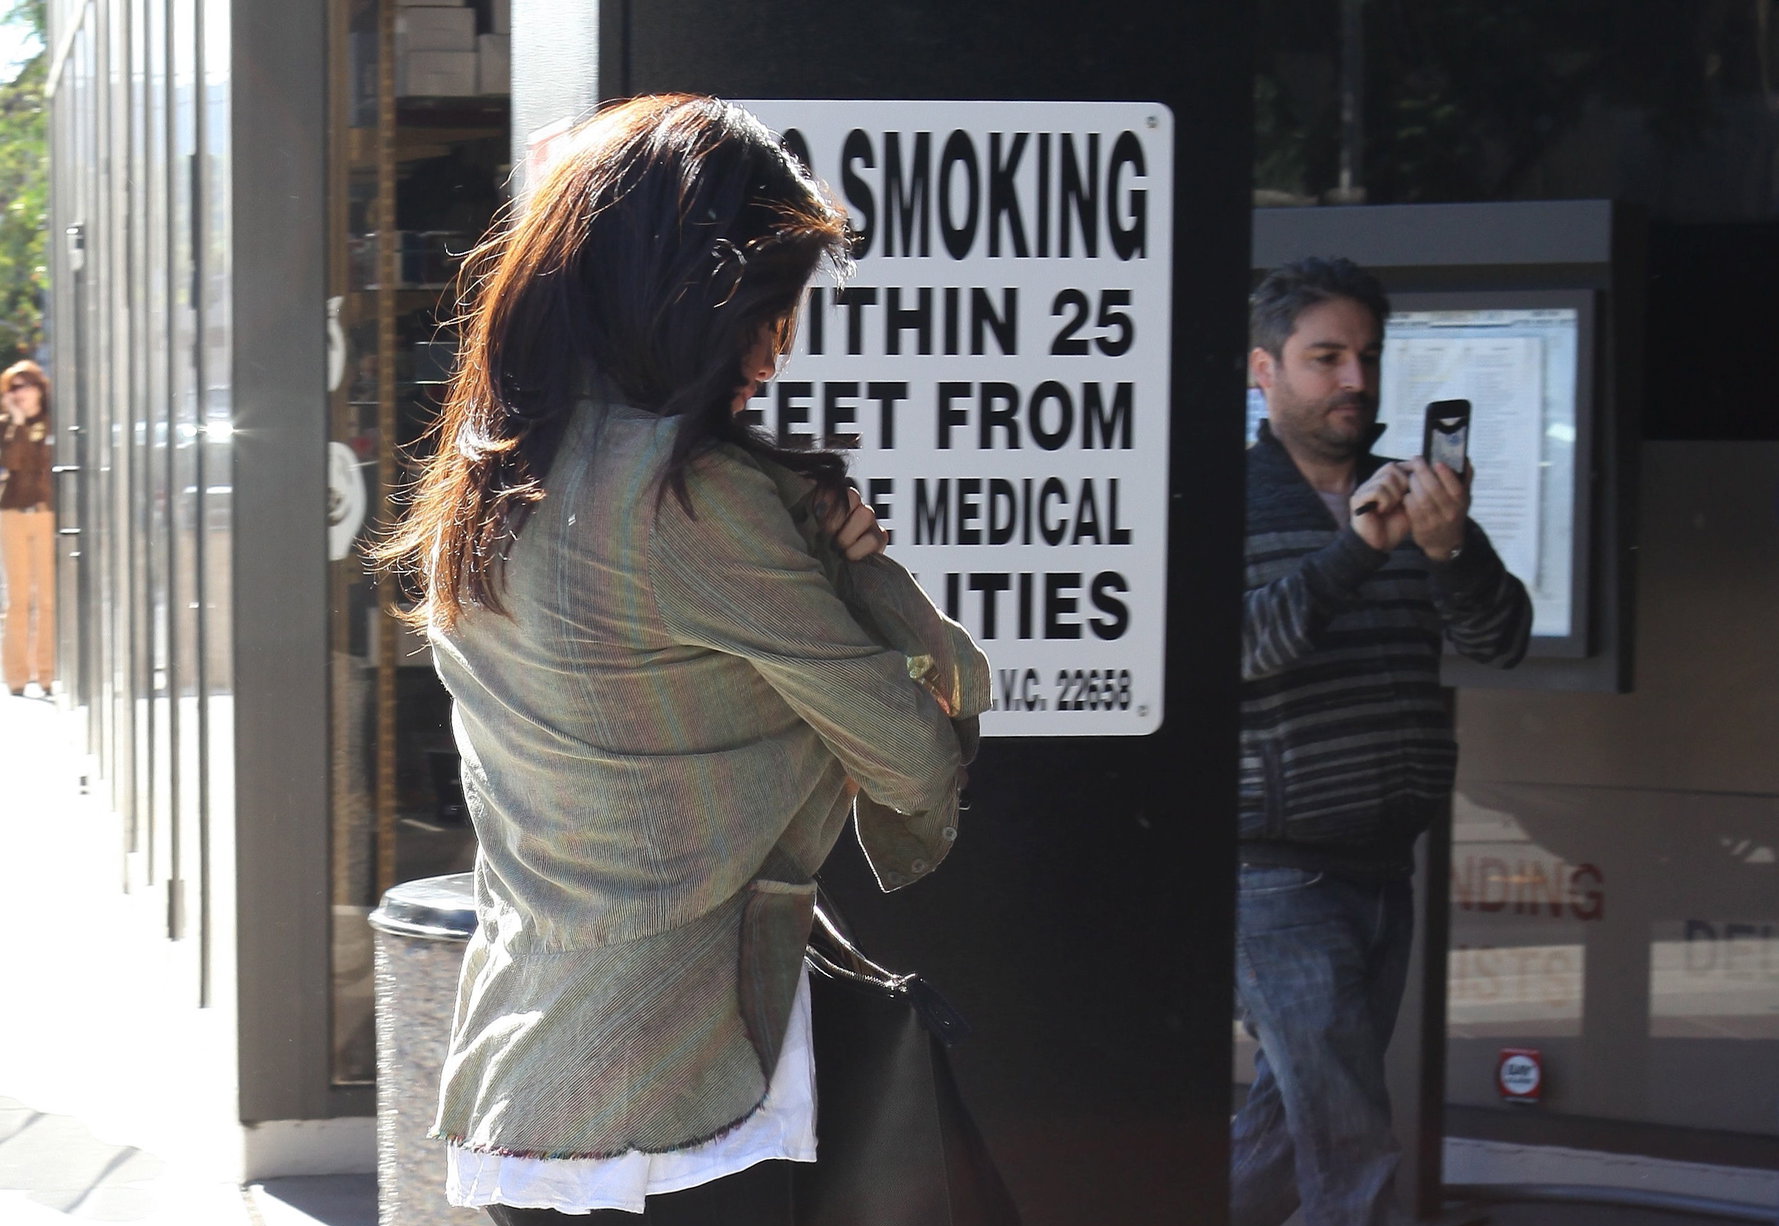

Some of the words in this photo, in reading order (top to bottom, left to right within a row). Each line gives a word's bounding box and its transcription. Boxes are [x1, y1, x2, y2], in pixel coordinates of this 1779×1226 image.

[842, 128, 1147, 261] SMOKING
[779, 287, 1018, 355] ITHIN
[1050, 288, 1134, 357] 25
[937, 381, 1133, 451] FROM
[913, 476, 1132, 546] MEDICAL
[911, 571, 1129, 641] ITIES
[1055, 669, 1132, 711] 22658
